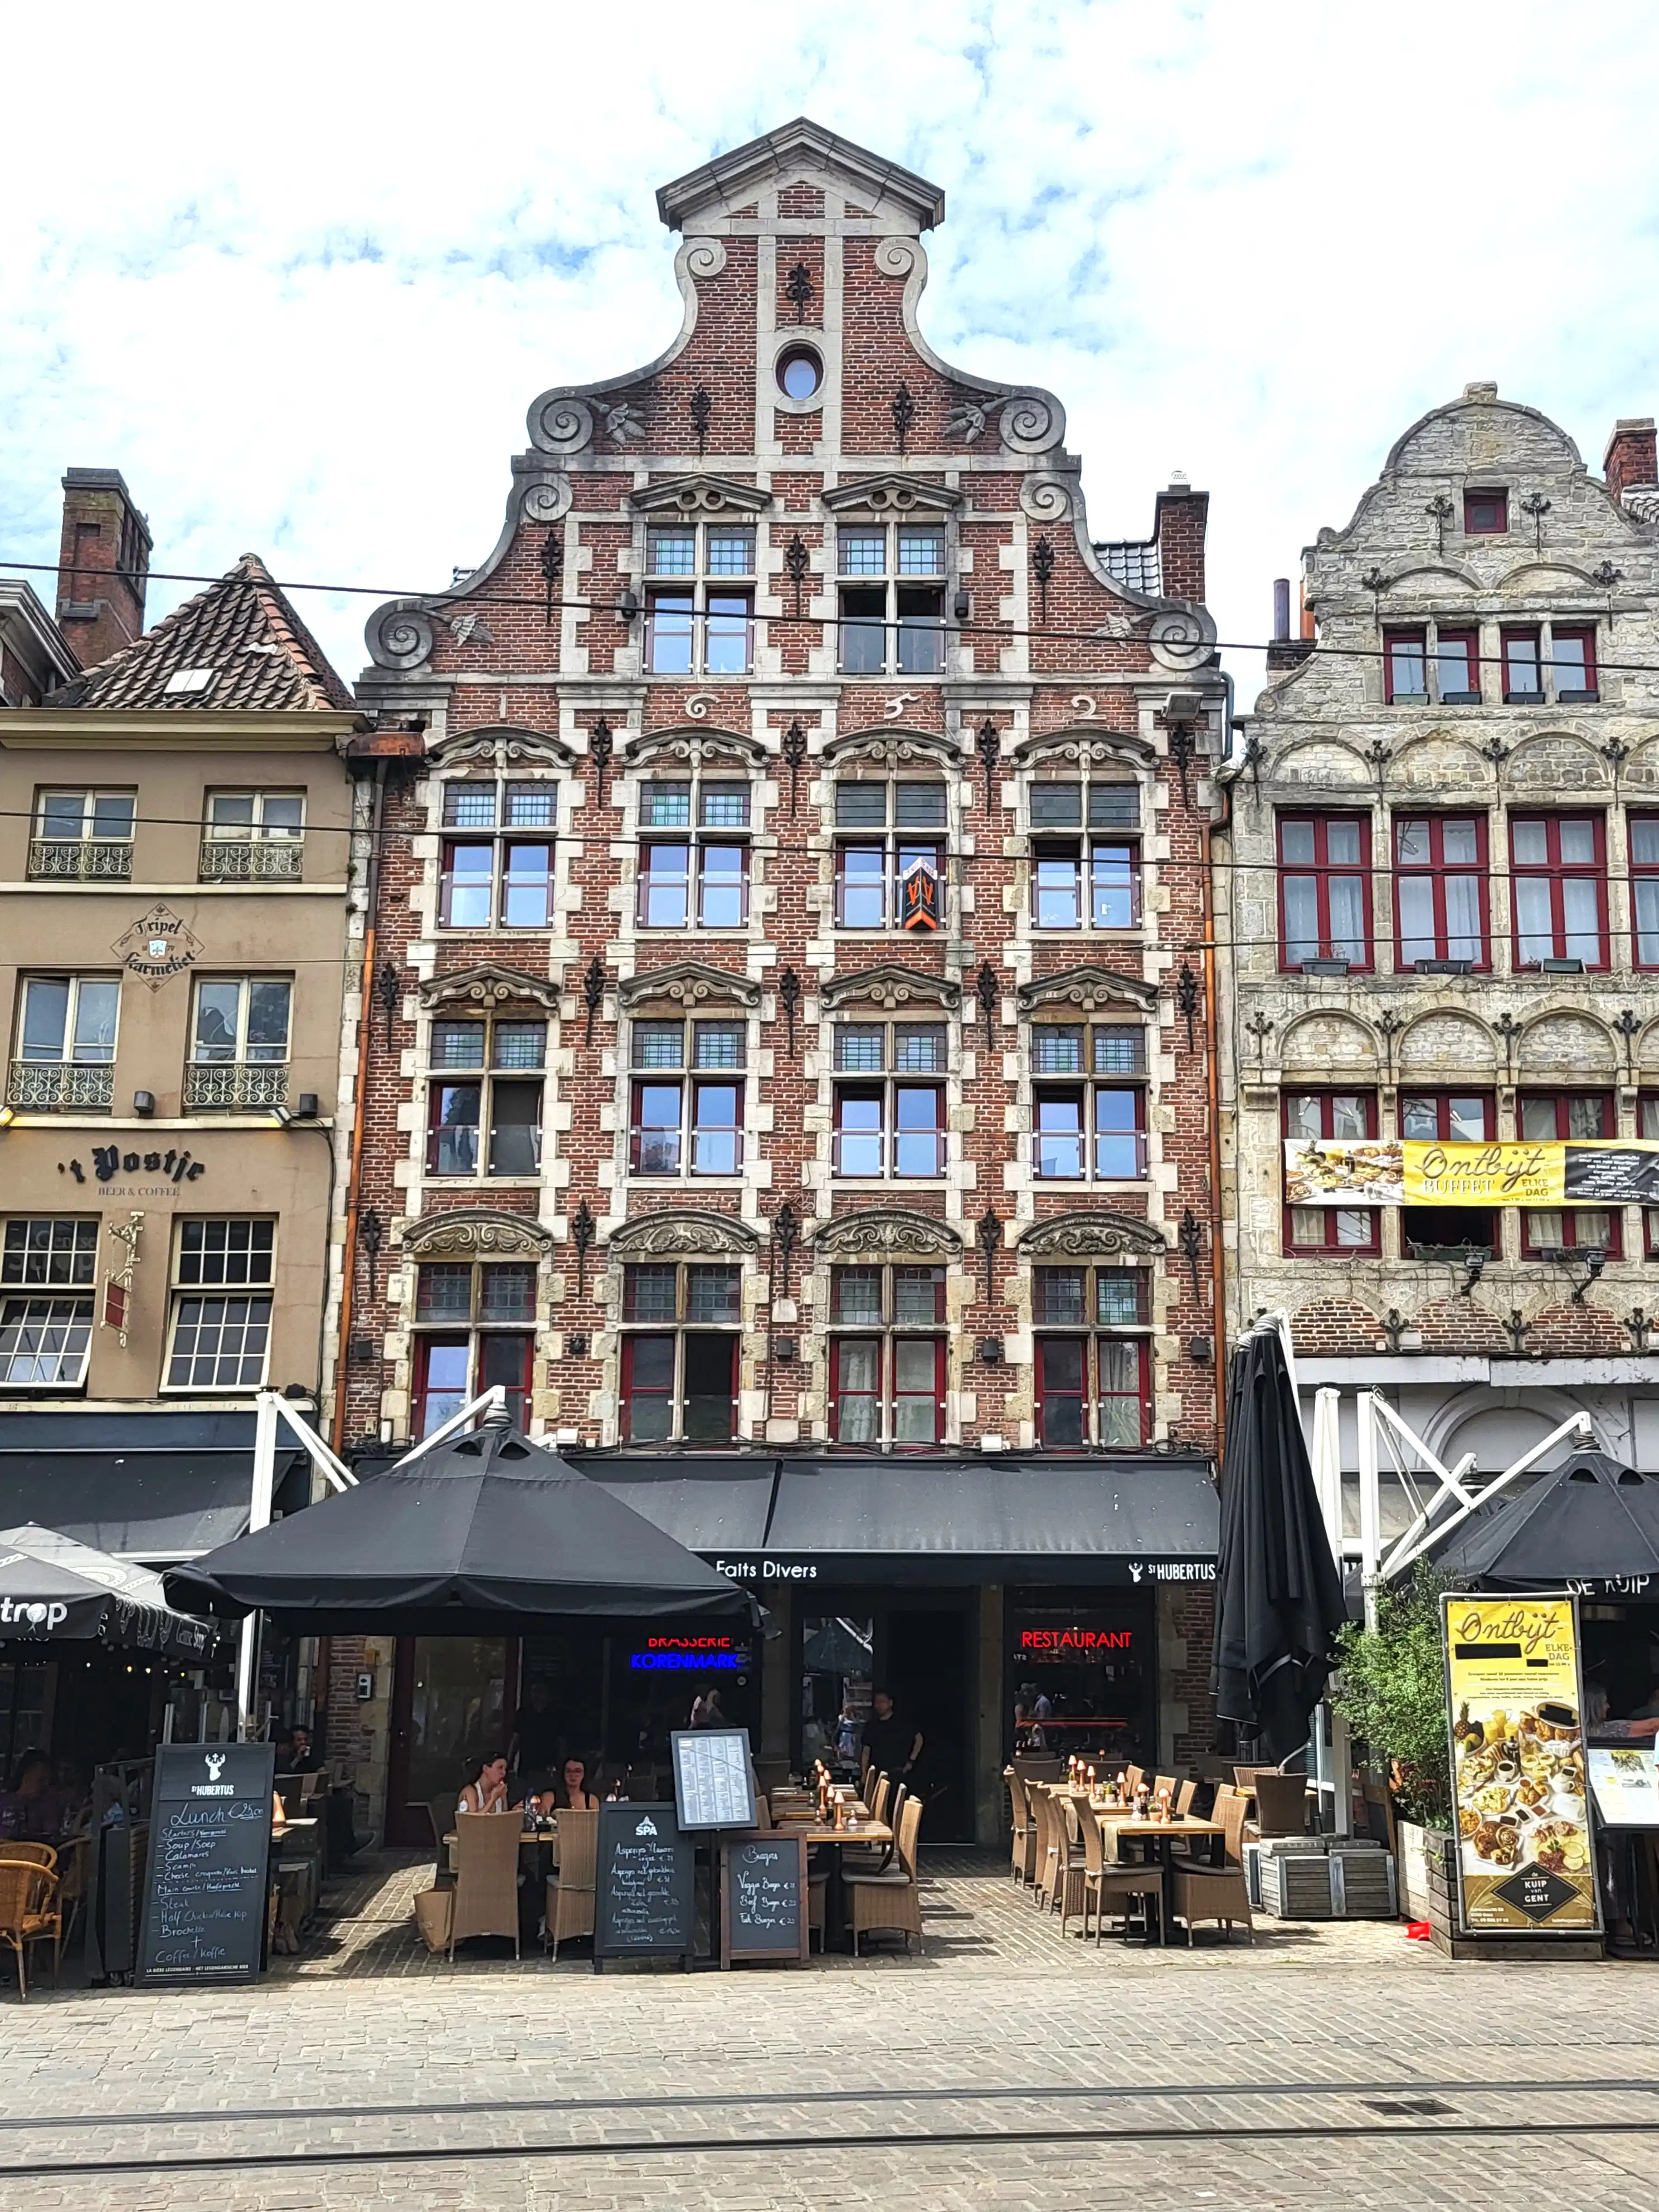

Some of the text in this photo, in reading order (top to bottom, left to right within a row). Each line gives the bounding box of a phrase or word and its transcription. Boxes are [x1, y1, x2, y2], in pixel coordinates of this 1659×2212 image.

[132, 915, 184, 937] Tripel
[91, 1144, 205, 1183] Postje
[1422, 1178, 1494, 1195] BUFFET
[1522, 1178, 1549, 1187] ELKE
[98, 1187, 179, 1197] BEER & COFFEE
[1526, 1188, 1548, 1196] DAG
[716, 1560, 816, 1578] Faits Divers
[1148, 1563, 1216, 1580] ST HUBERTUS
[1566, 1578, 1595, 1596] DE
[0, 1597, 67, 1630] trop
[1021, 1631, 1132, 1648] RESTAURANT
[1545, 1644, 1570, 1652] ELKE
[631, 1653, 744, 1669] KORENMARK
[196, 1785, 234, 1796] HUBERTUS
[171, 1802, 227, 1826] Lunch
[635, 1826, 658, 1835] SPA
[158, 1884, 179, 1895] Main
[1525, 1880, 1547, 1888] KUIP
[1525, 1894, 1549, 1902] GENT
[161, 1910, 182, 1926] Half
